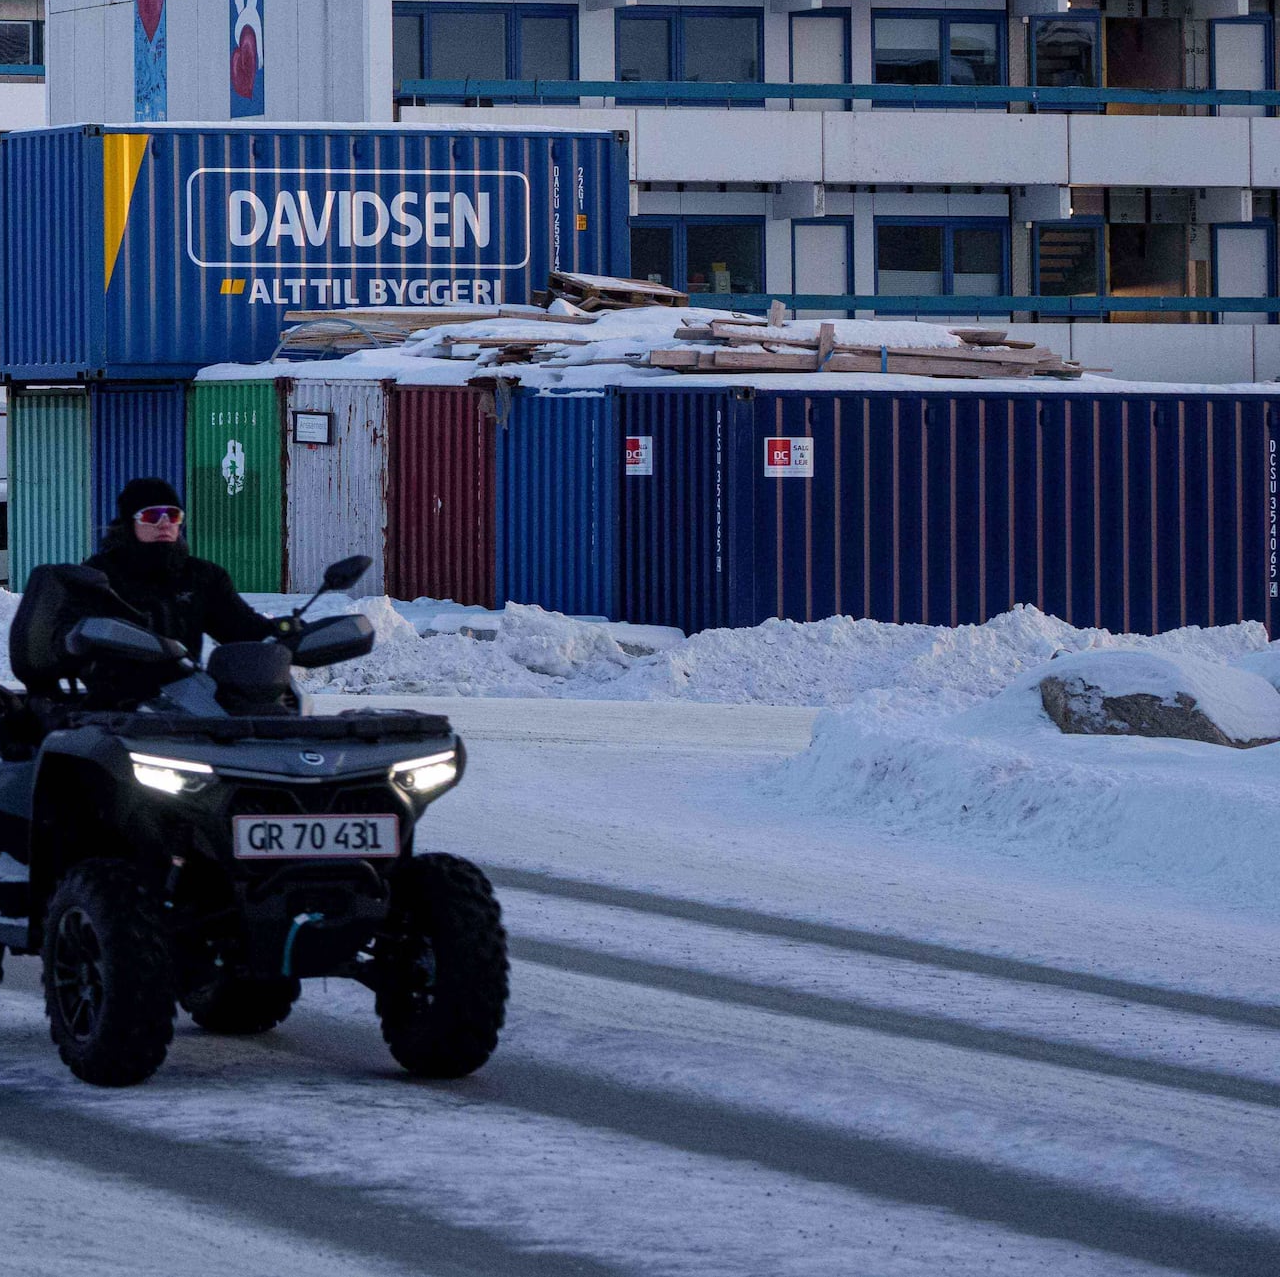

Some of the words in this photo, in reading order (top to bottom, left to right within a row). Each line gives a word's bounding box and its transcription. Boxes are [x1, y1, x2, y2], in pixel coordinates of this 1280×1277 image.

[229, 190, 490, 248] DAVIDSEN
[248, 279, 306, 304] ALT
[308, 279, 359, 304] TIL
[369, 279, 501, 305] BYGGERI
[774, 451, 789, 460] DC
[248, 822, 285, 851] GR
[293, 822, 326, 850] 70
[334, 821, 382, 850] 431
